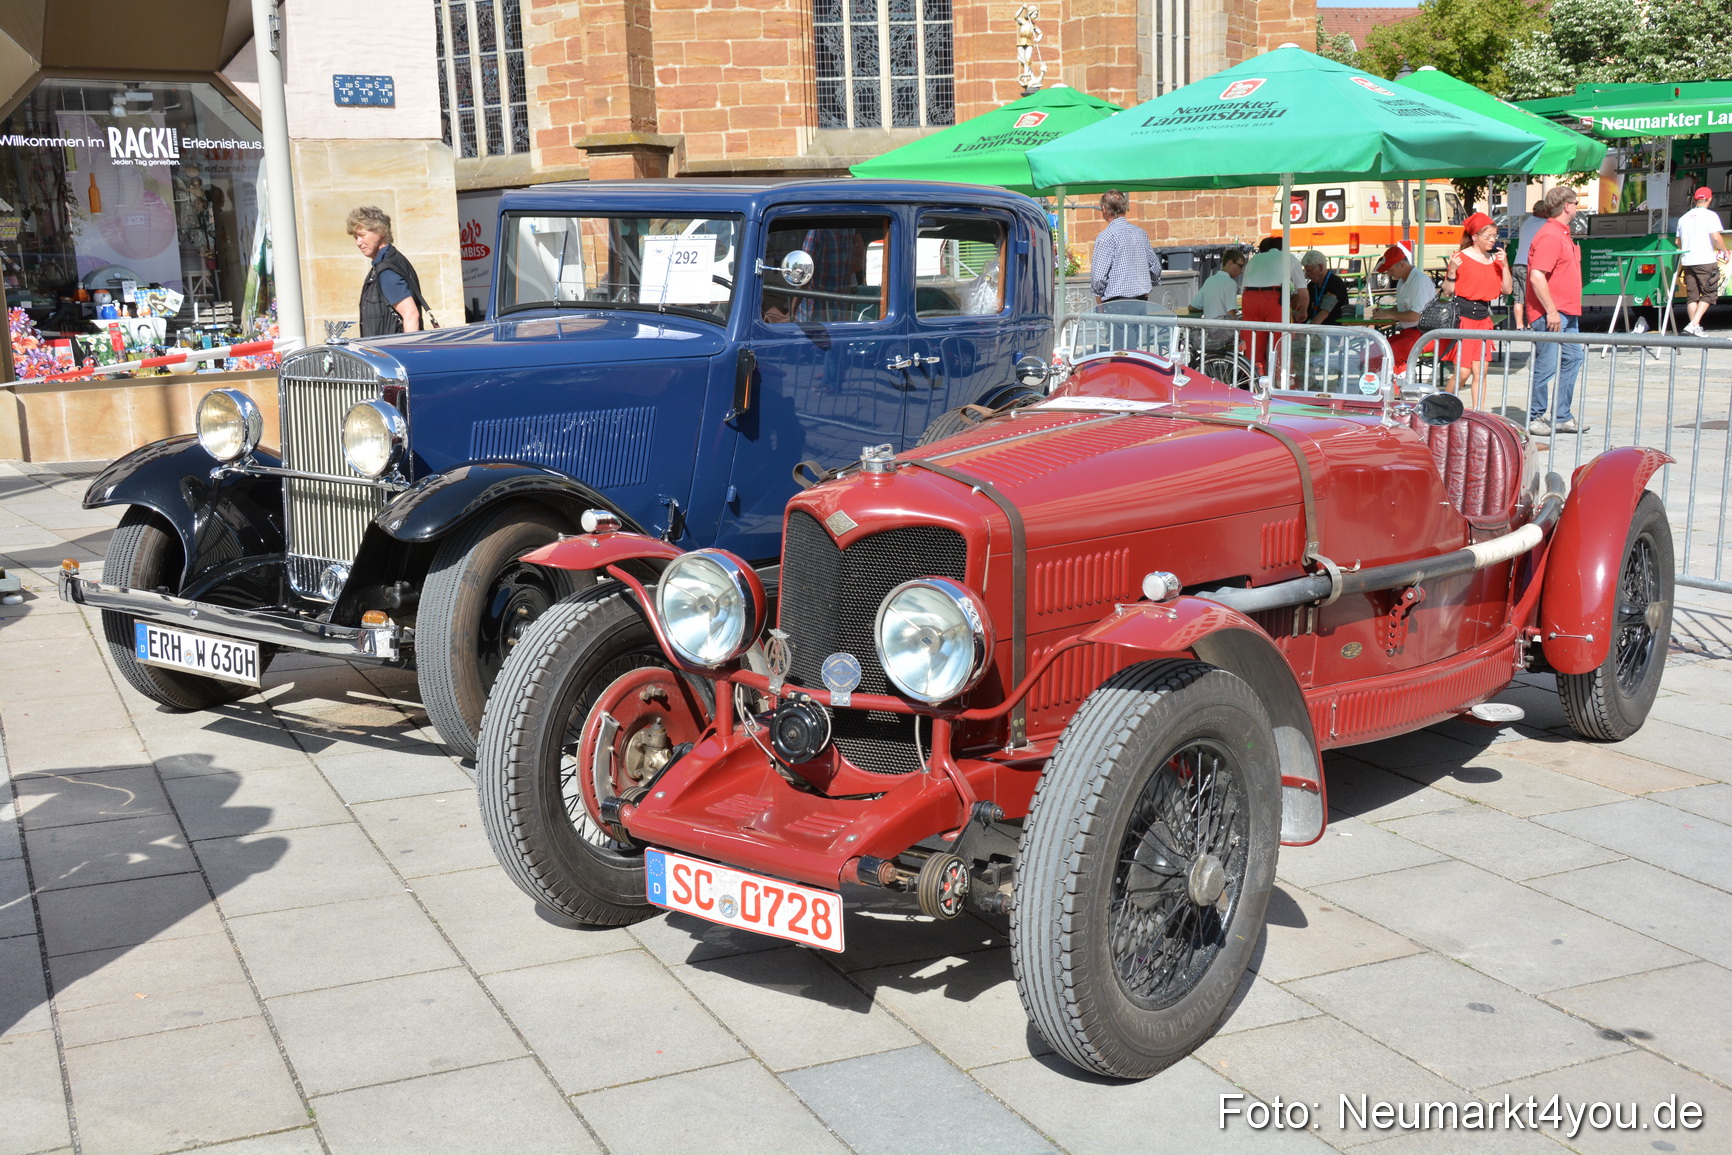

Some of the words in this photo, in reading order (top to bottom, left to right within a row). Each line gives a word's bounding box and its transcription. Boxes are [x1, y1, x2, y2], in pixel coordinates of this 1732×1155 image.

[1172, 101, 1279, 115] Neumarkter
[1140, 107, 1288, 127] Lammsbräu
[1602, 113, 1703, 131] Neumarkter
[1708, 110, 1732, 126] La
[0, 135, 85, 147] Willkommen
[87, 137, 105, 147] im
[107, 127, 180, 159] RACKL
[182, 137, 265, 149] Erlebnishaus.
[953, 136, 1059, 152] Lammsbr
[977, 130, 1063, 143] Neumarkter
[460, 246, 486, 258] MBISS
[675, 251, 698, 265] 292
[140, 644, 146, 653] D
[149, 630, 182, 662] ERH
[196, 639, 206, 667] W
[211, 643, 256, 678] 630H
[653, 882, 661, 894] D
[672, 863, 714, 911] SC
[741, 880, 832, 940] 0728
